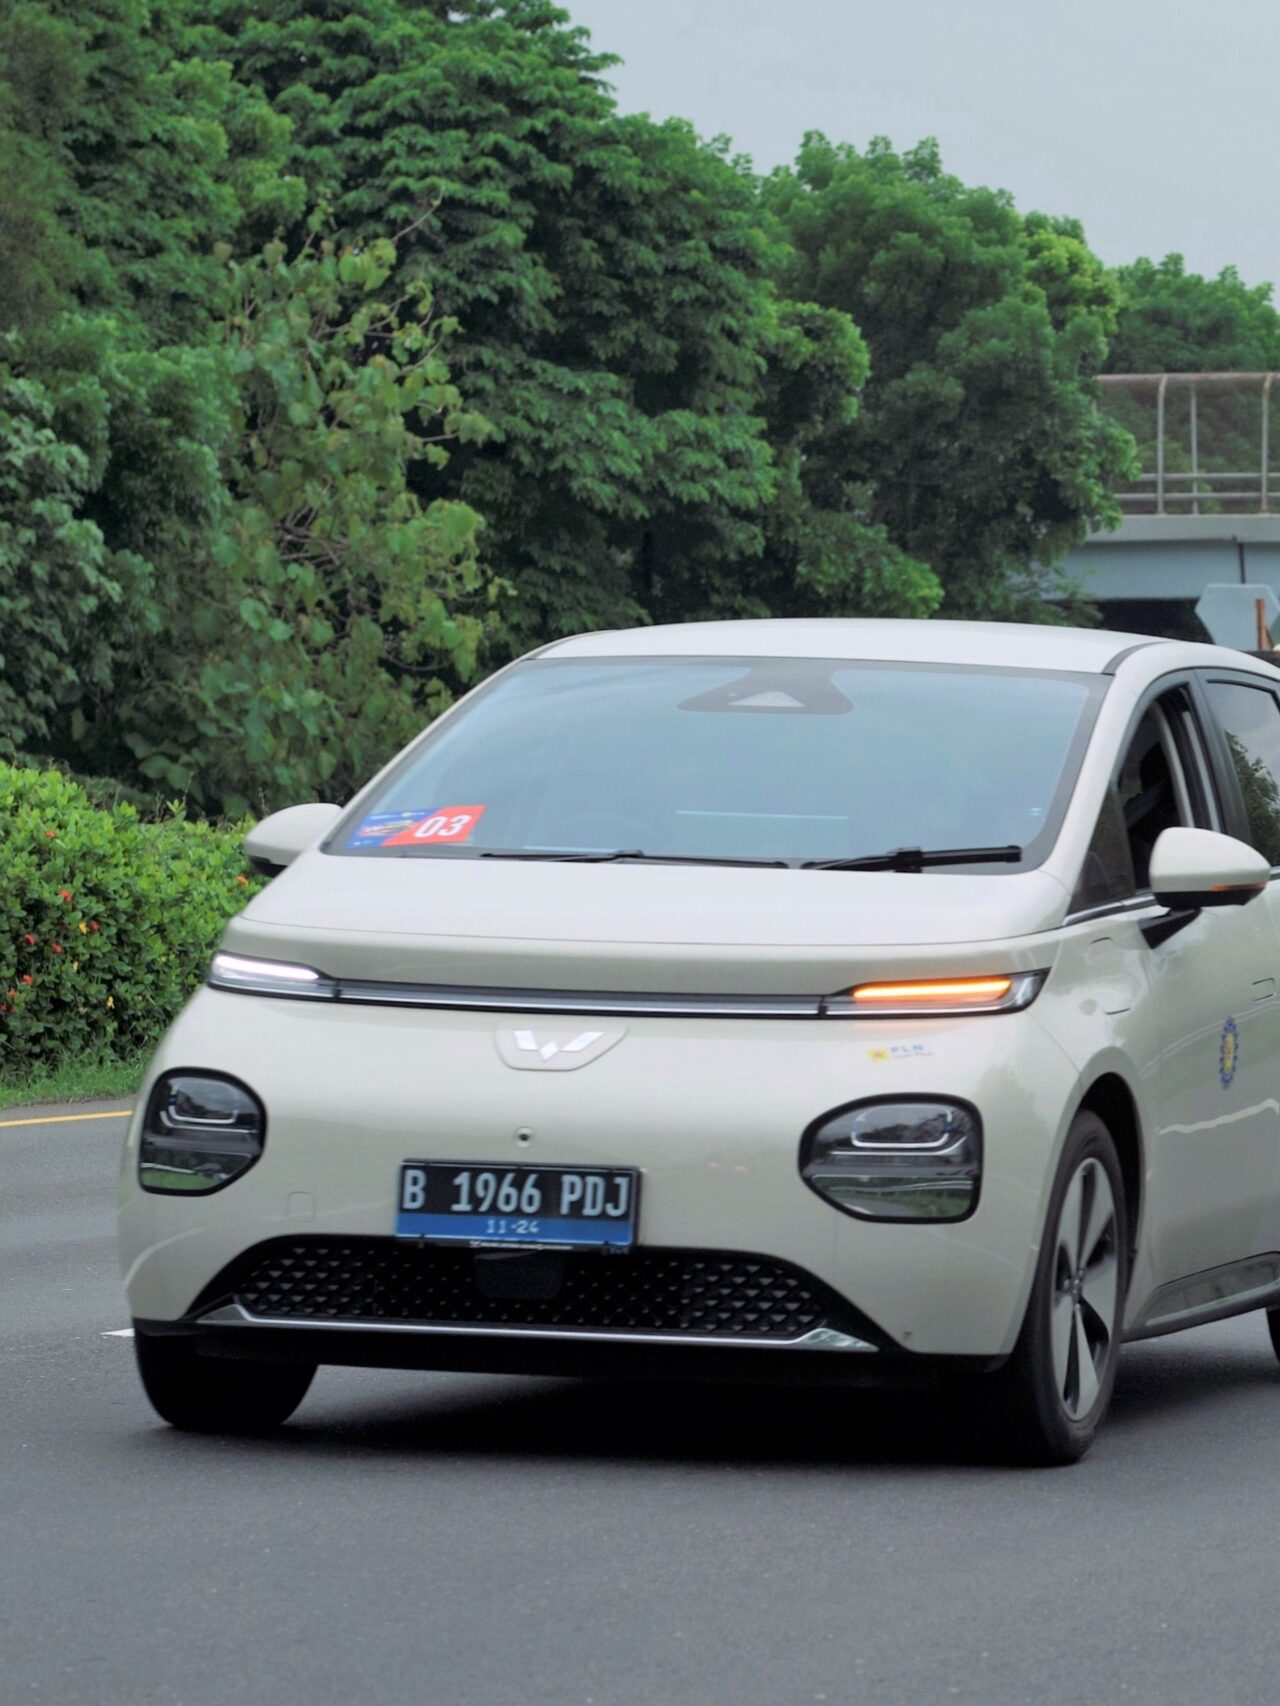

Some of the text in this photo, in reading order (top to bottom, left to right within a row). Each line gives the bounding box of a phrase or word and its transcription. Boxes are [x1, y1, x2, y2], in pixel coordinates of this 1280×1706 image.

[414, 814, 471, 838] 03
[402, 1169, 630, 1217] B 1966 PDJ
[485, 1219, 539, 1235] 11-24
